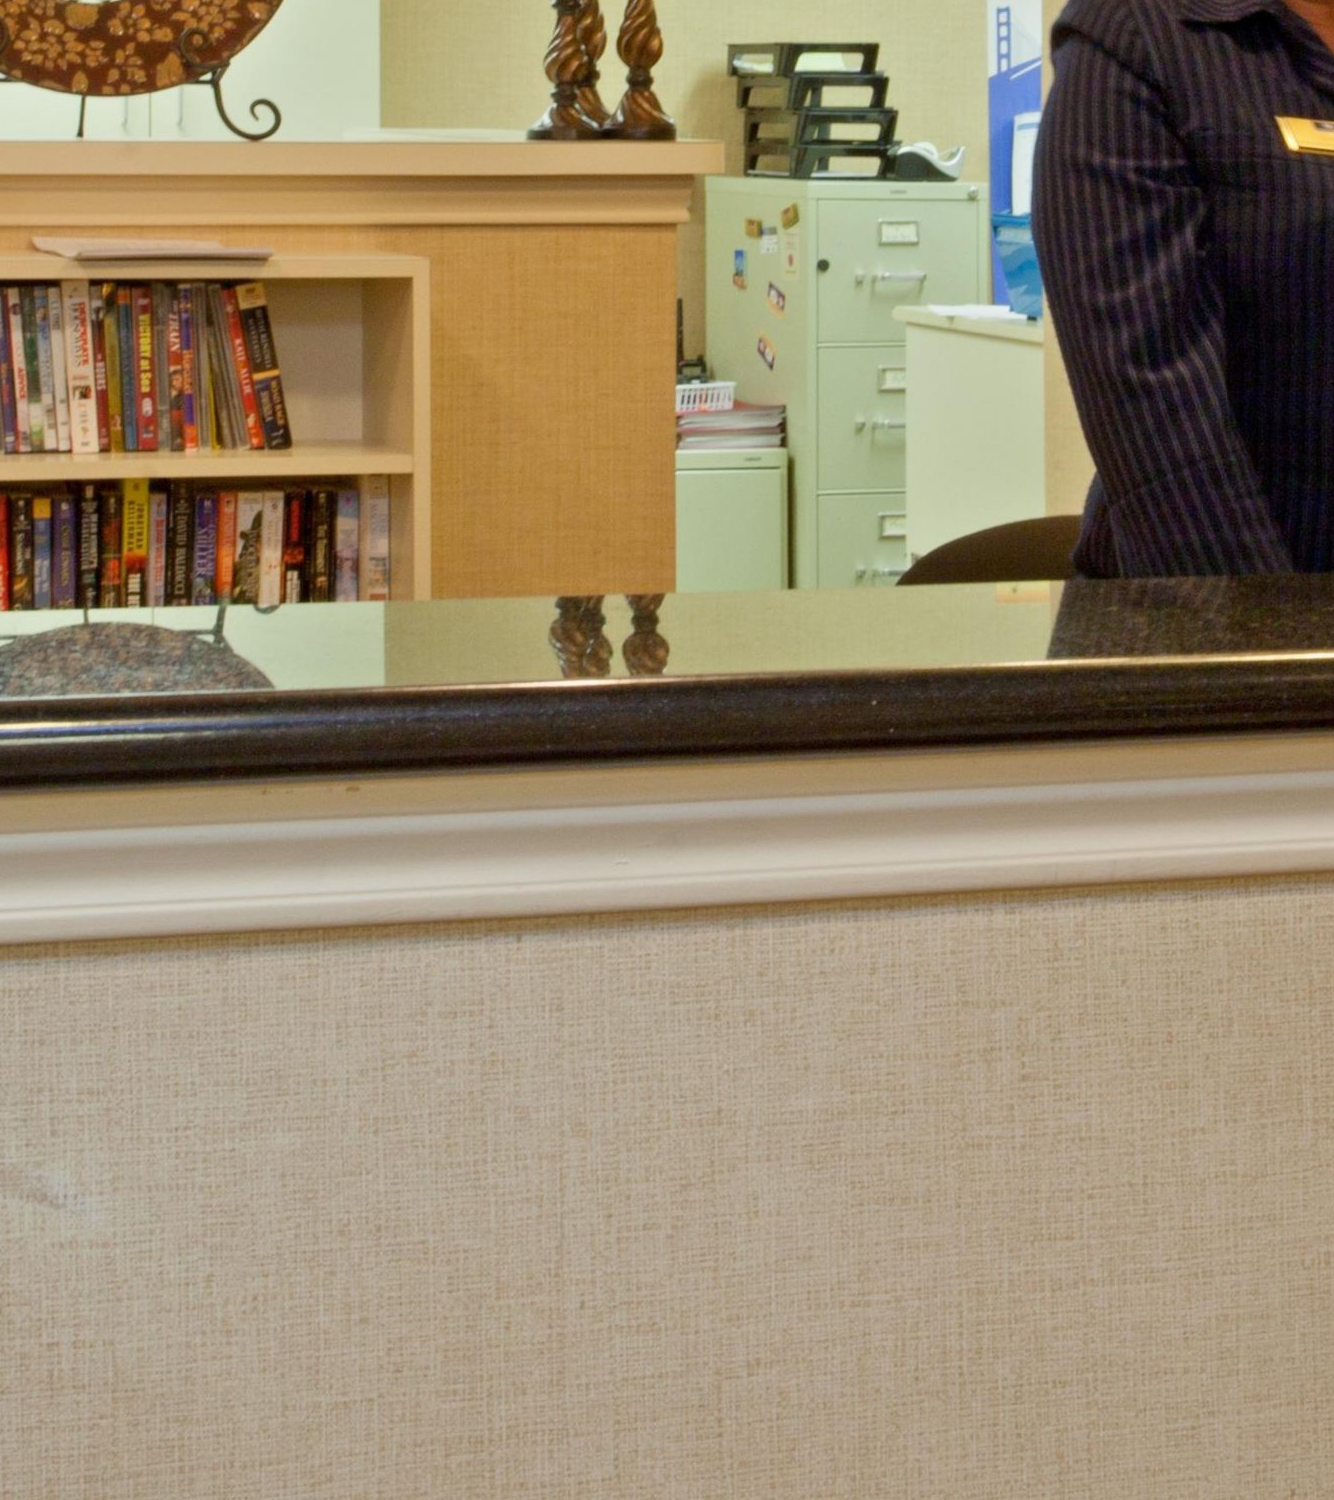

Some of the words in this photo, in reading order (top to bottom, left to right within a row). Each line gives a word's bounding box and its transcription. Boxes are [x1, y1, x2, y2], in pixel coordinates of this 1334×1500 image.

[138, 313, 152, 357] VICTORY
[168, 313, 180, 352] TRAIN
[140, 358, 150, 370] at
[140, 371, 152, 392] Sea
[136, 503, 144, 548] JONATHAN
[175, 515, 186, 545] DAVID
[174, 547, 186, 594] BALDACCI
